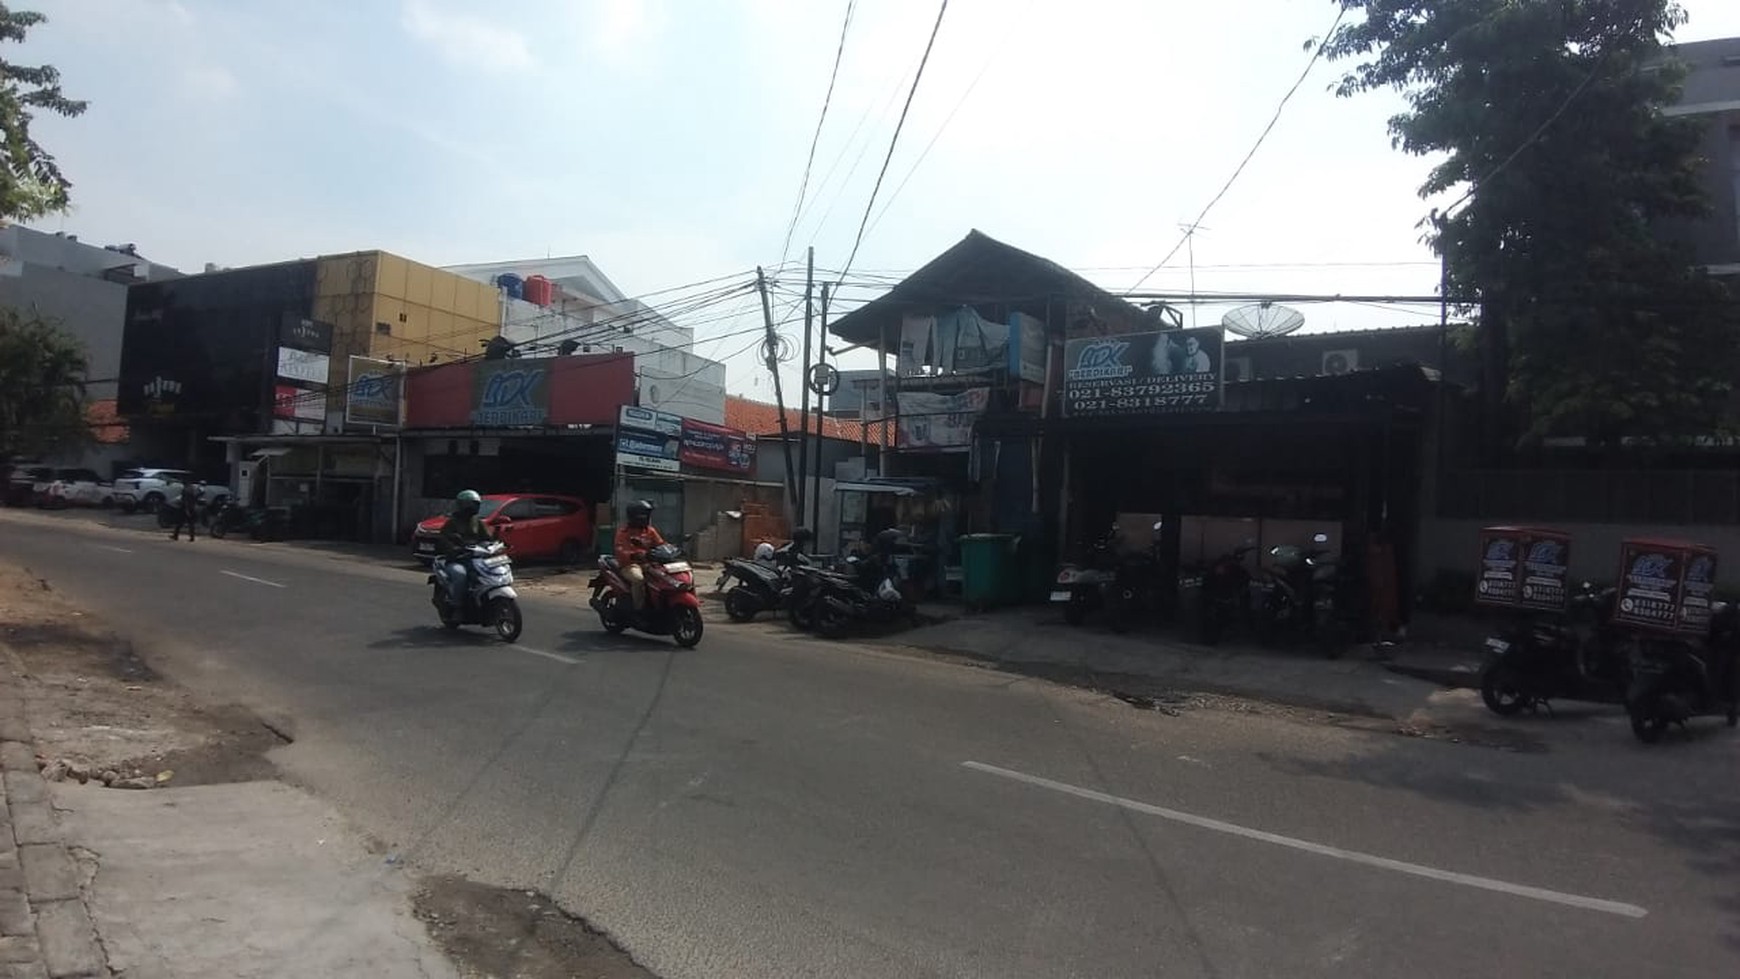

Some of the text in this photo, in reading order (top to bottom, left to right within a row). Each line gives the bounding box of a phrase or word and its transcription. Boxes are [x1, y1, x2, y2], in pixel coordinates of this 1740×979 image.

[1069, 378, 1136, 389] RESERVASI
[1147, 372, 1217, 384] DELIVERY
[1069, 382, 1215, 399] 021-83792365
[1074, 394, 1208, 410] 021-8318777
